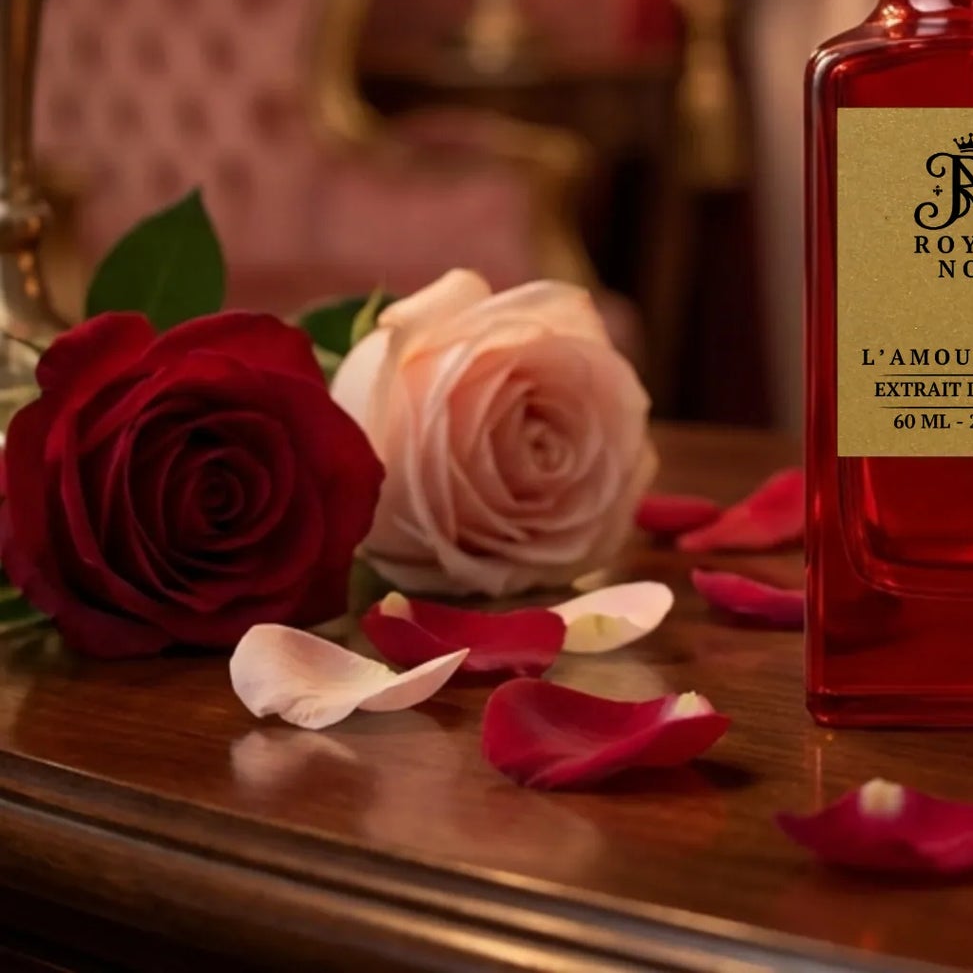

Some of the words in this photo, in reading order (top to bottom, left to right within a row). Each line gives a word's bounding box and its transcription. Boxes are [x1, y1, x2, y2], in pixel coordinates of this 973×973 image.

[874, 381, 962, 398] EXTRAIT
[893, 413, 916, 430] 60
[920, 413, 951, 430] ML
